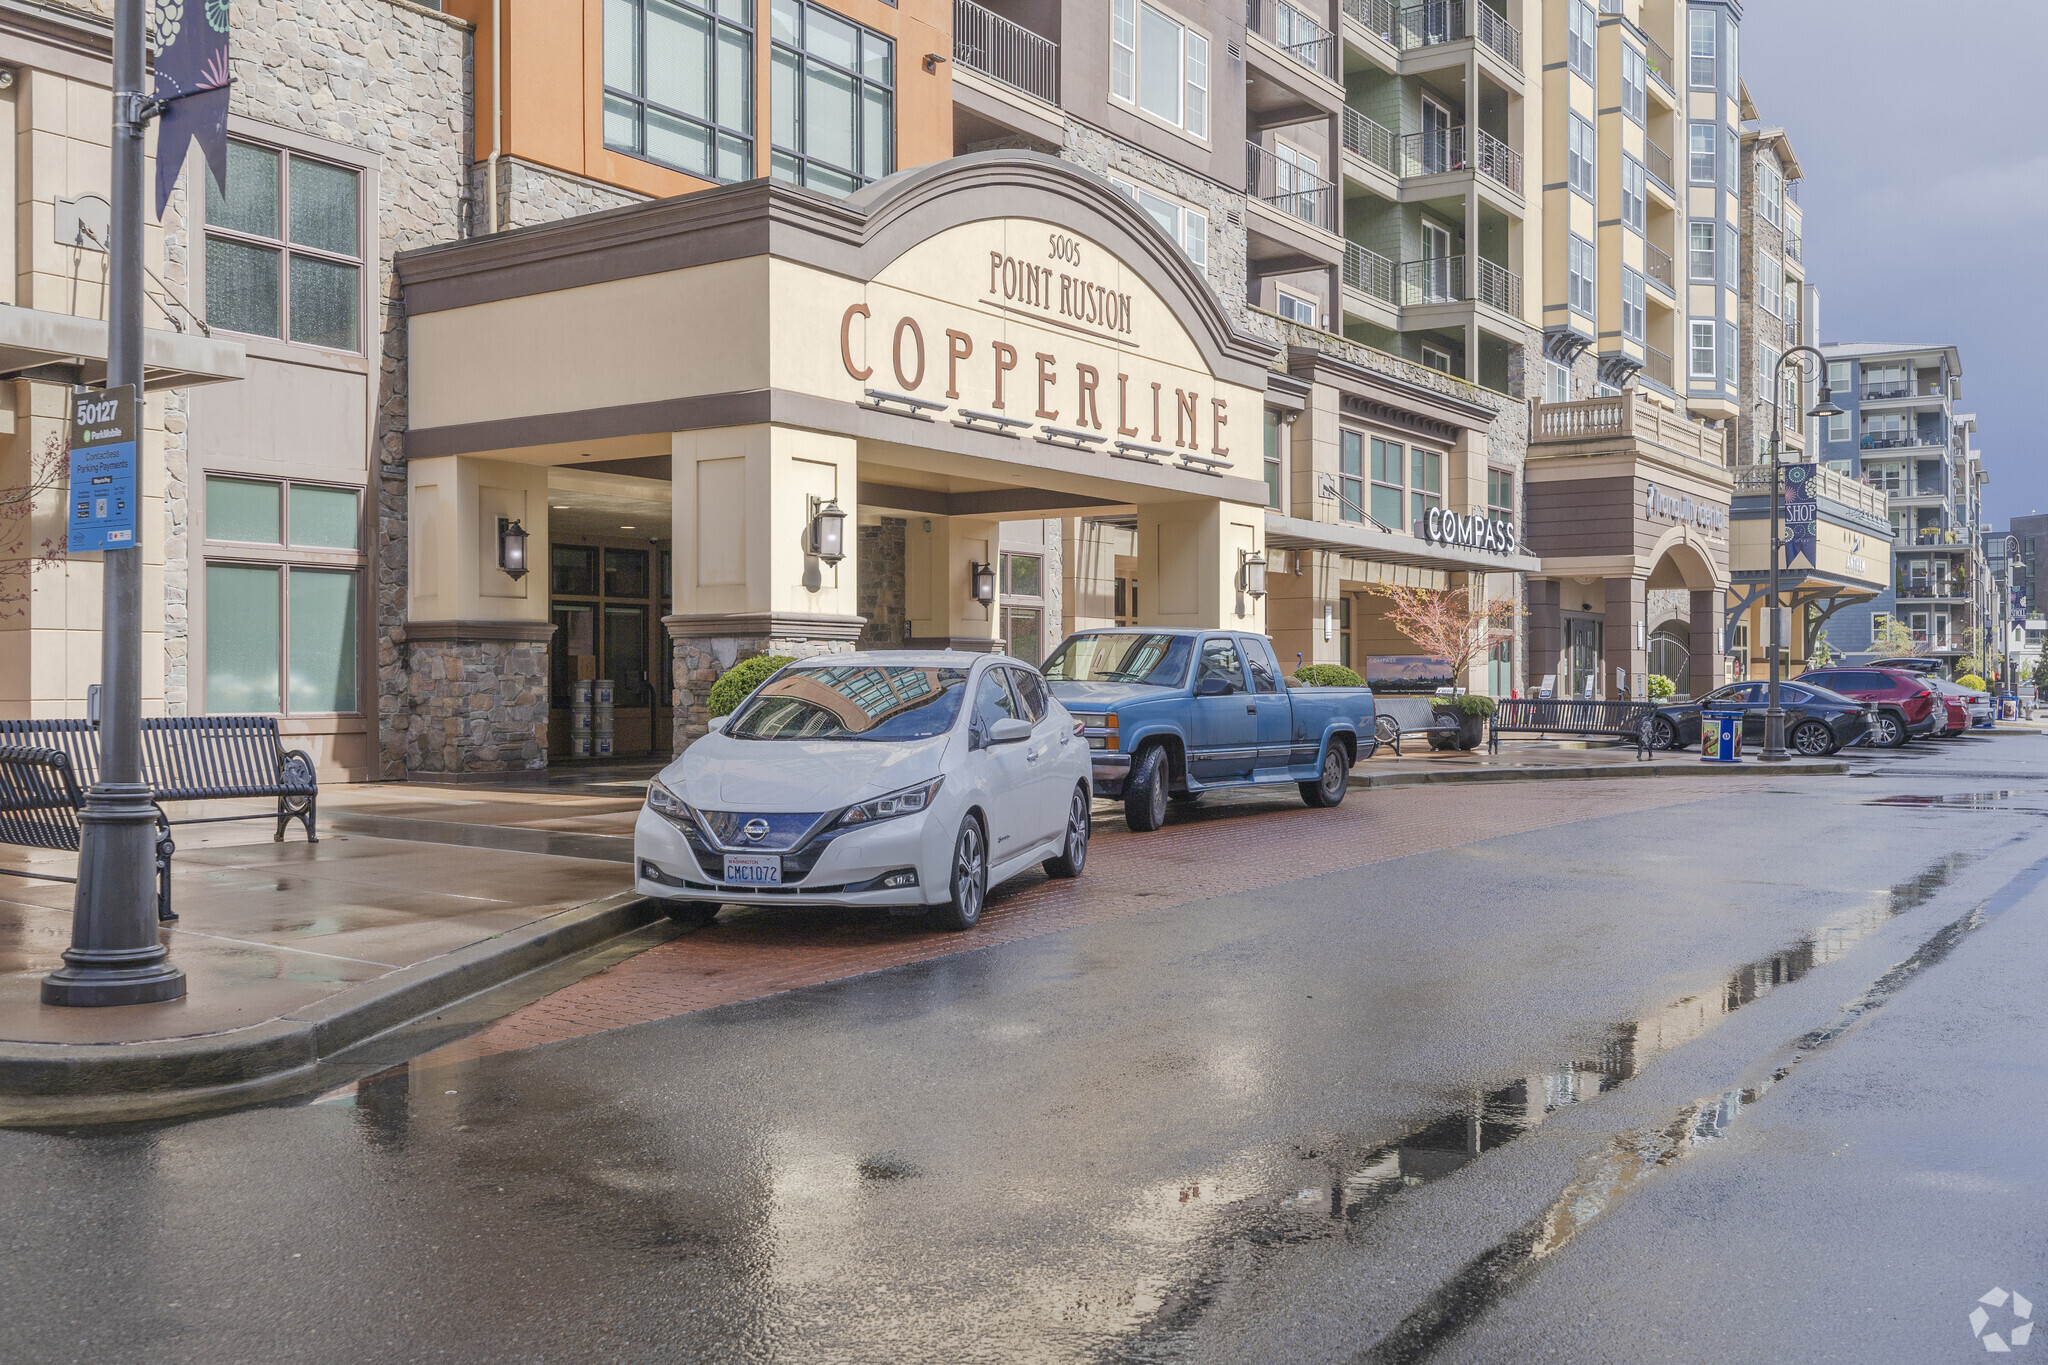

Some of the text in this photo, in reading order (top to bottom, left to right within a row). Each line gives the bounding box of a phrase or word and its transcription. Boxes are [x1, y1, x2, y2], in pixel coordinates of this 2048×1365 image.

[1048, 233, 1081, 268] 5005
[990, 250, 1132, 335] POINT RUSTON
[840, 302, 1230, 458] COPPERLINE
[77, 400, 119, 426] 50127
[91, 427, 122, 440] ParkMobile
[77, 460, 129, 474] Parking Payments
[86, 450, 120, 462] Contactless
[1786, 504, 1816, 522] SHOP
[1428, 506, 1515, 552] COMPASS
[727, 865, 777, 881] CMC1072
